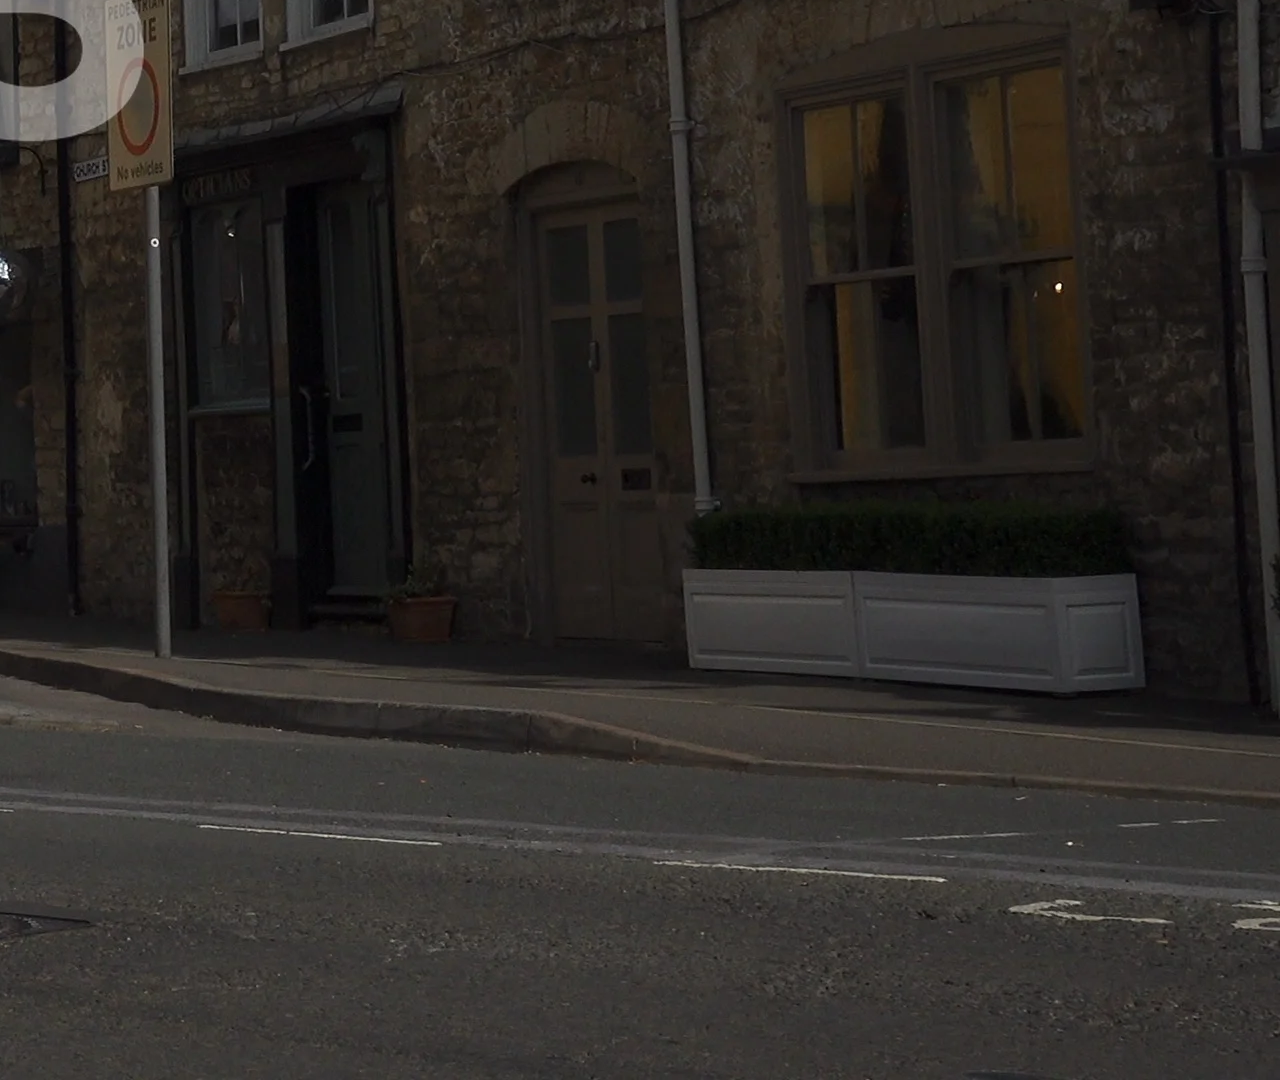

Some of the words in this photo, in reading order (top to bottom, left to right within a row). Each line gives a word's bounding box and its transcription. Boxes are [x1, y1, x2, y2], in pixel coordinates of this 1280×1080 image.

[116, 16, 157, 50] ZONE
[116, 165, 129, 182] No
[130, 160, 164, 179] vehicles
